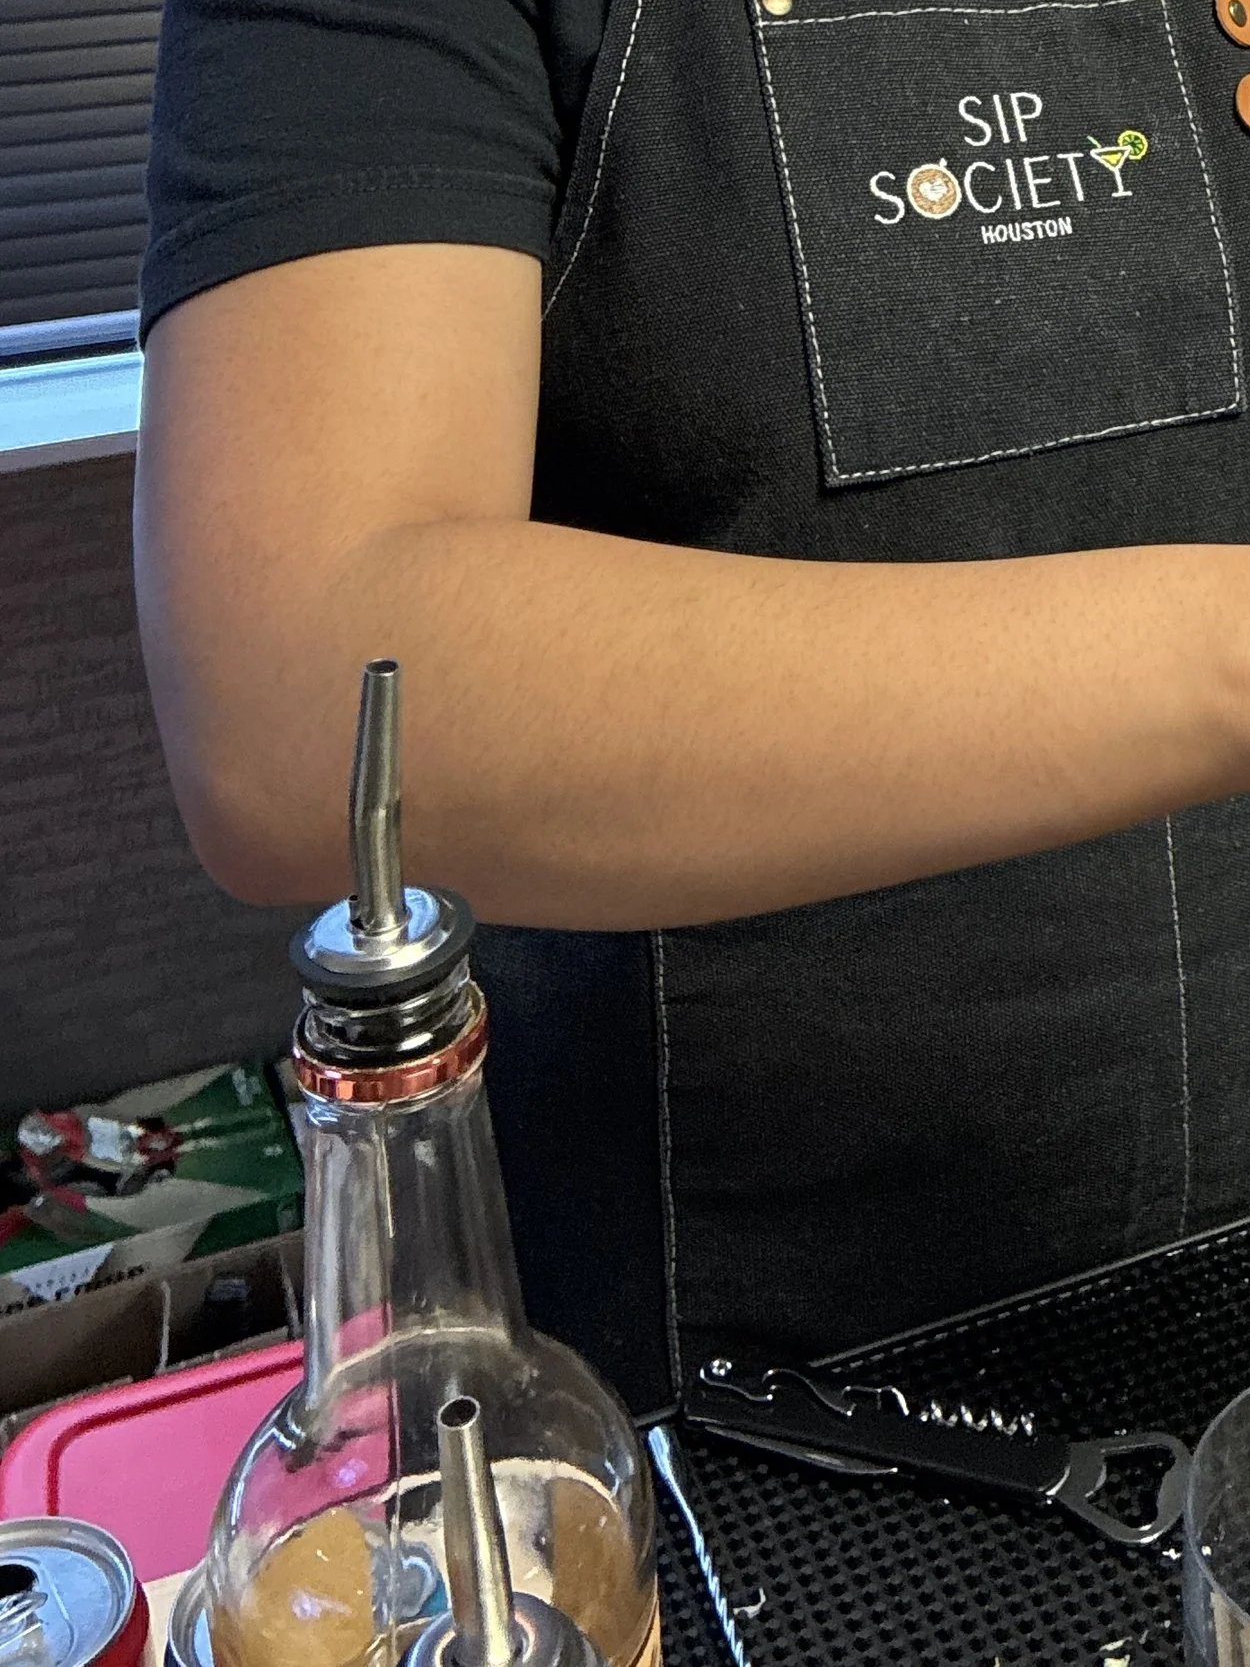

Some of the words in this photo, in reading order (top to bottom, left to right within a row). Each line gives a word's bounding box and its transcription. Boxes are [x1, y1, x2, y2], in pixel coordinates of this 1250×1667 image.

[958, 91, 1043, 147] SIP
[869, 144, 1134, 225] SOCIETY
[980, 216, 1074, 244] HOUSTON
